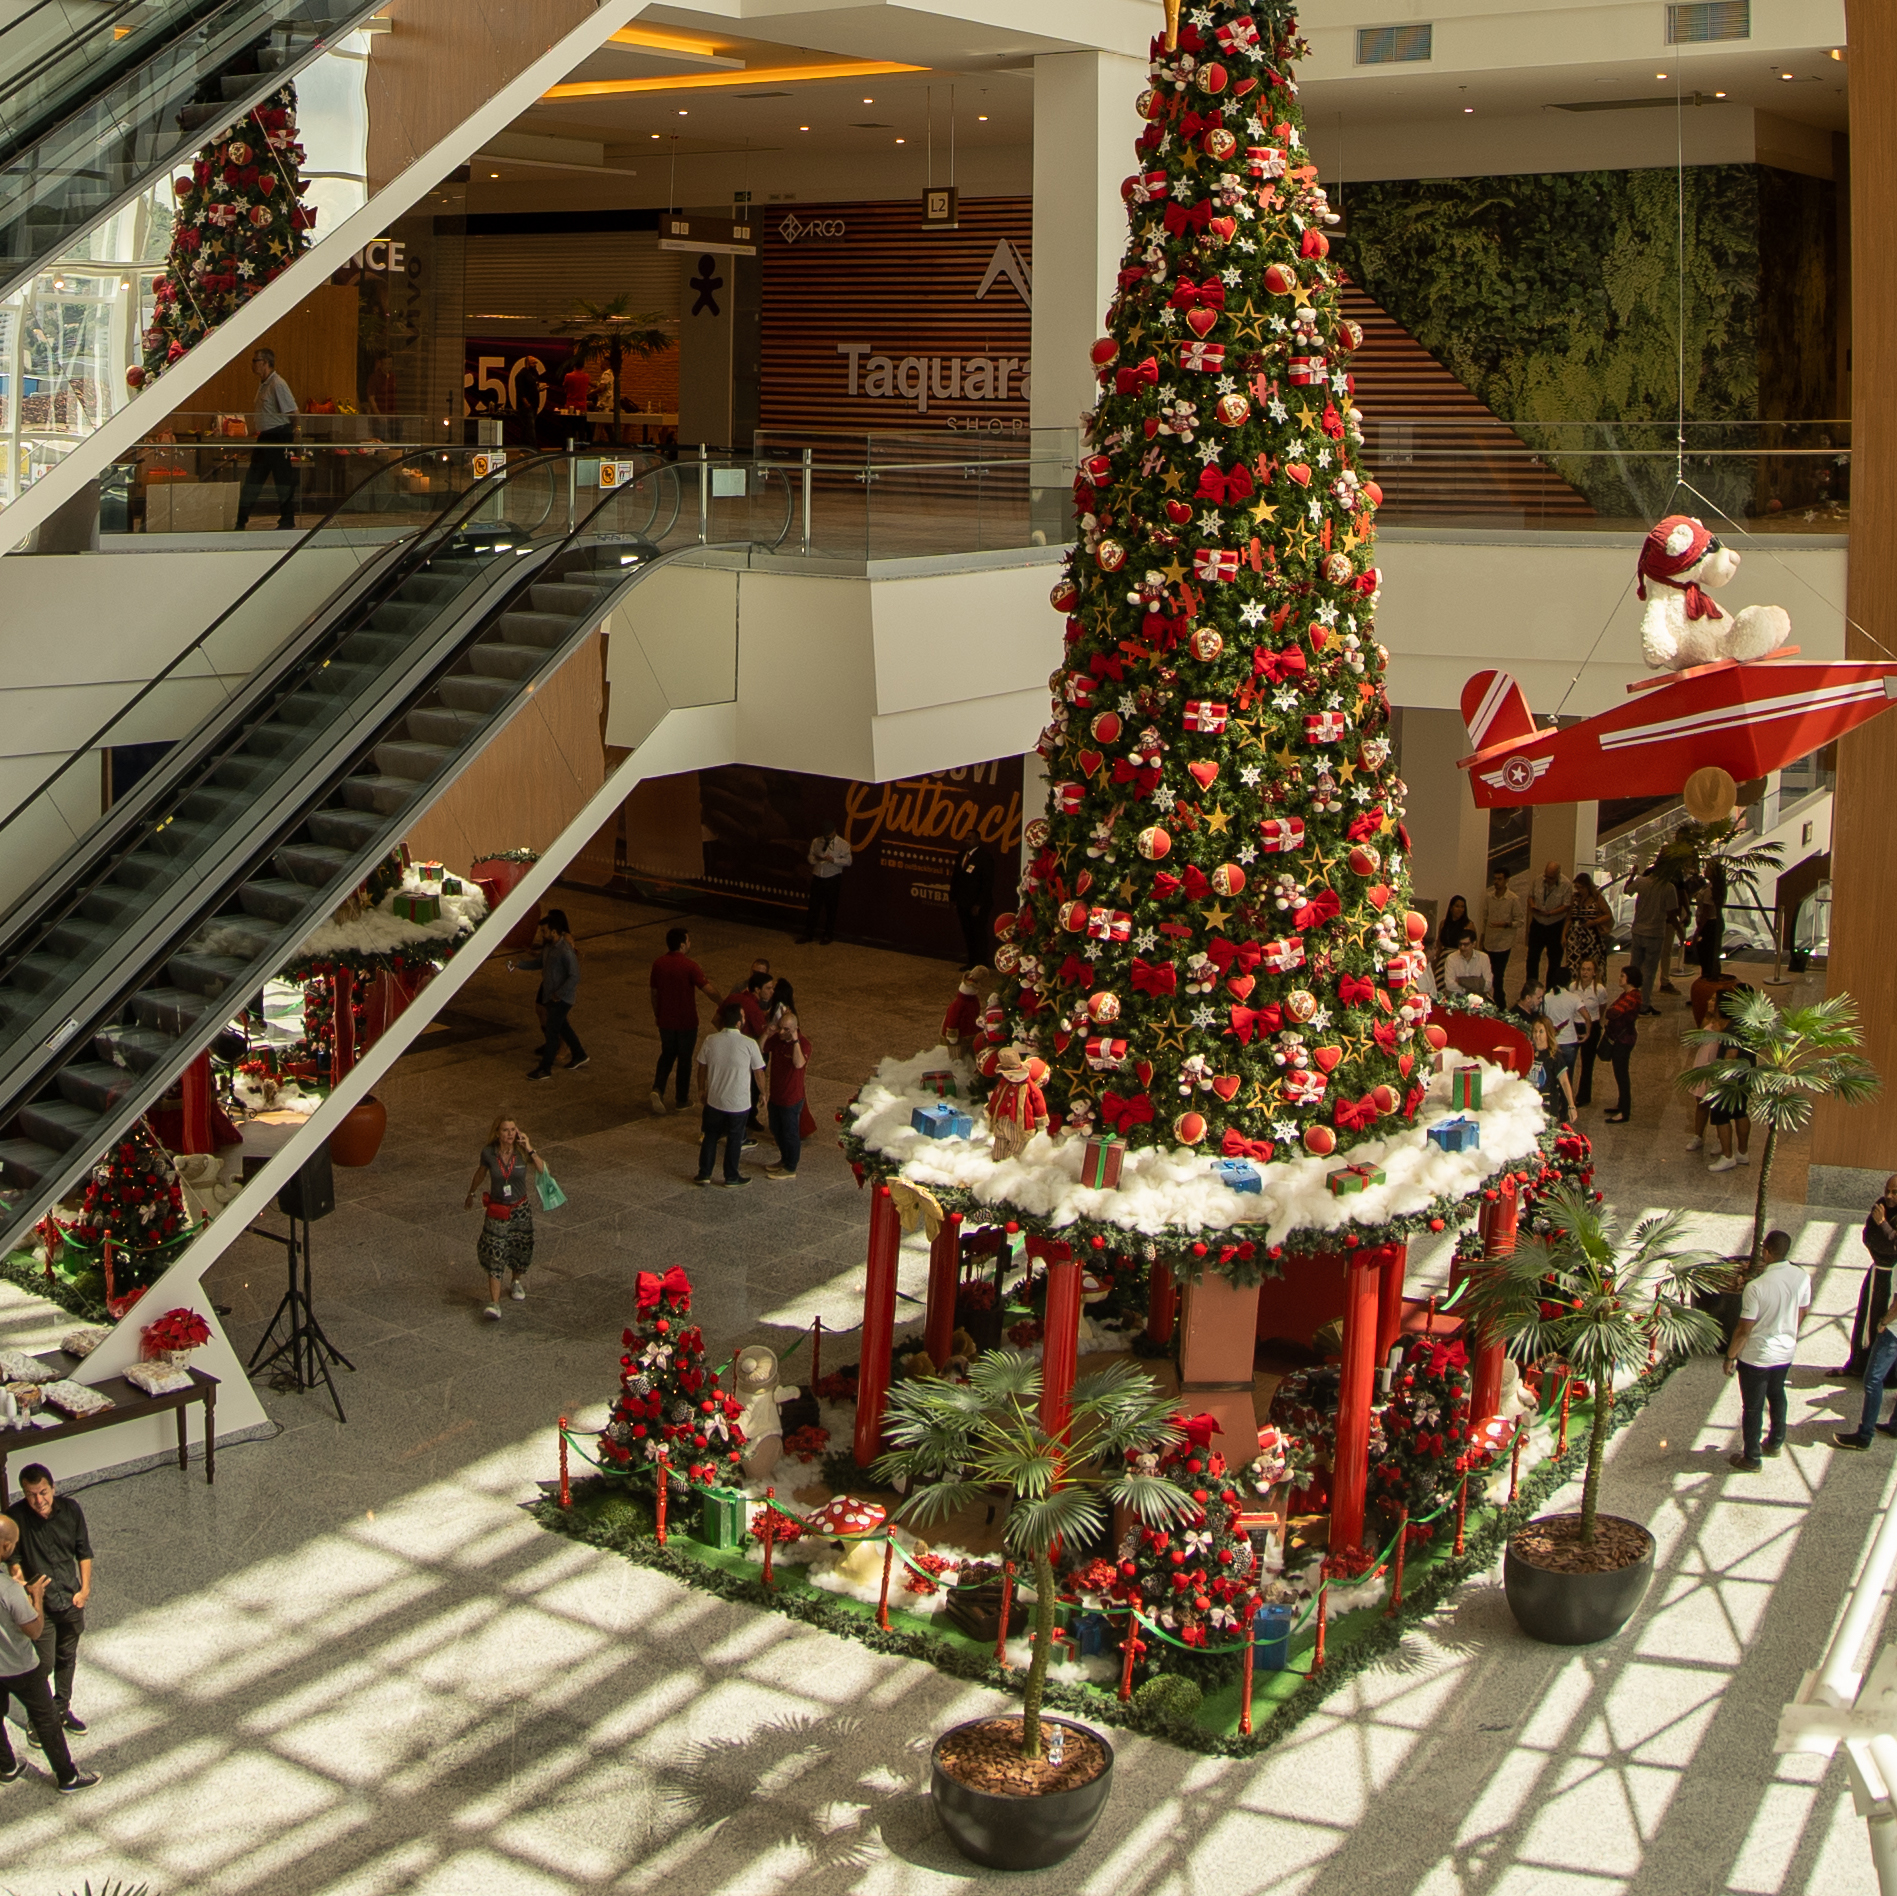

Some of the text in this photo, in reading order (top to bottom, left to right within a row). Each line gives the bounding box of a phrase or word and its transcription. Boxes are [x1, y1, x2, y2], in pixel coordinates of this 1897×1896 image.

[931, 198, 947, 213] L2
[801, 220, 845, 237] ARGO
[844, 778, 1022, 853] Outback
[910, 886, 950, 903] OUTBA
